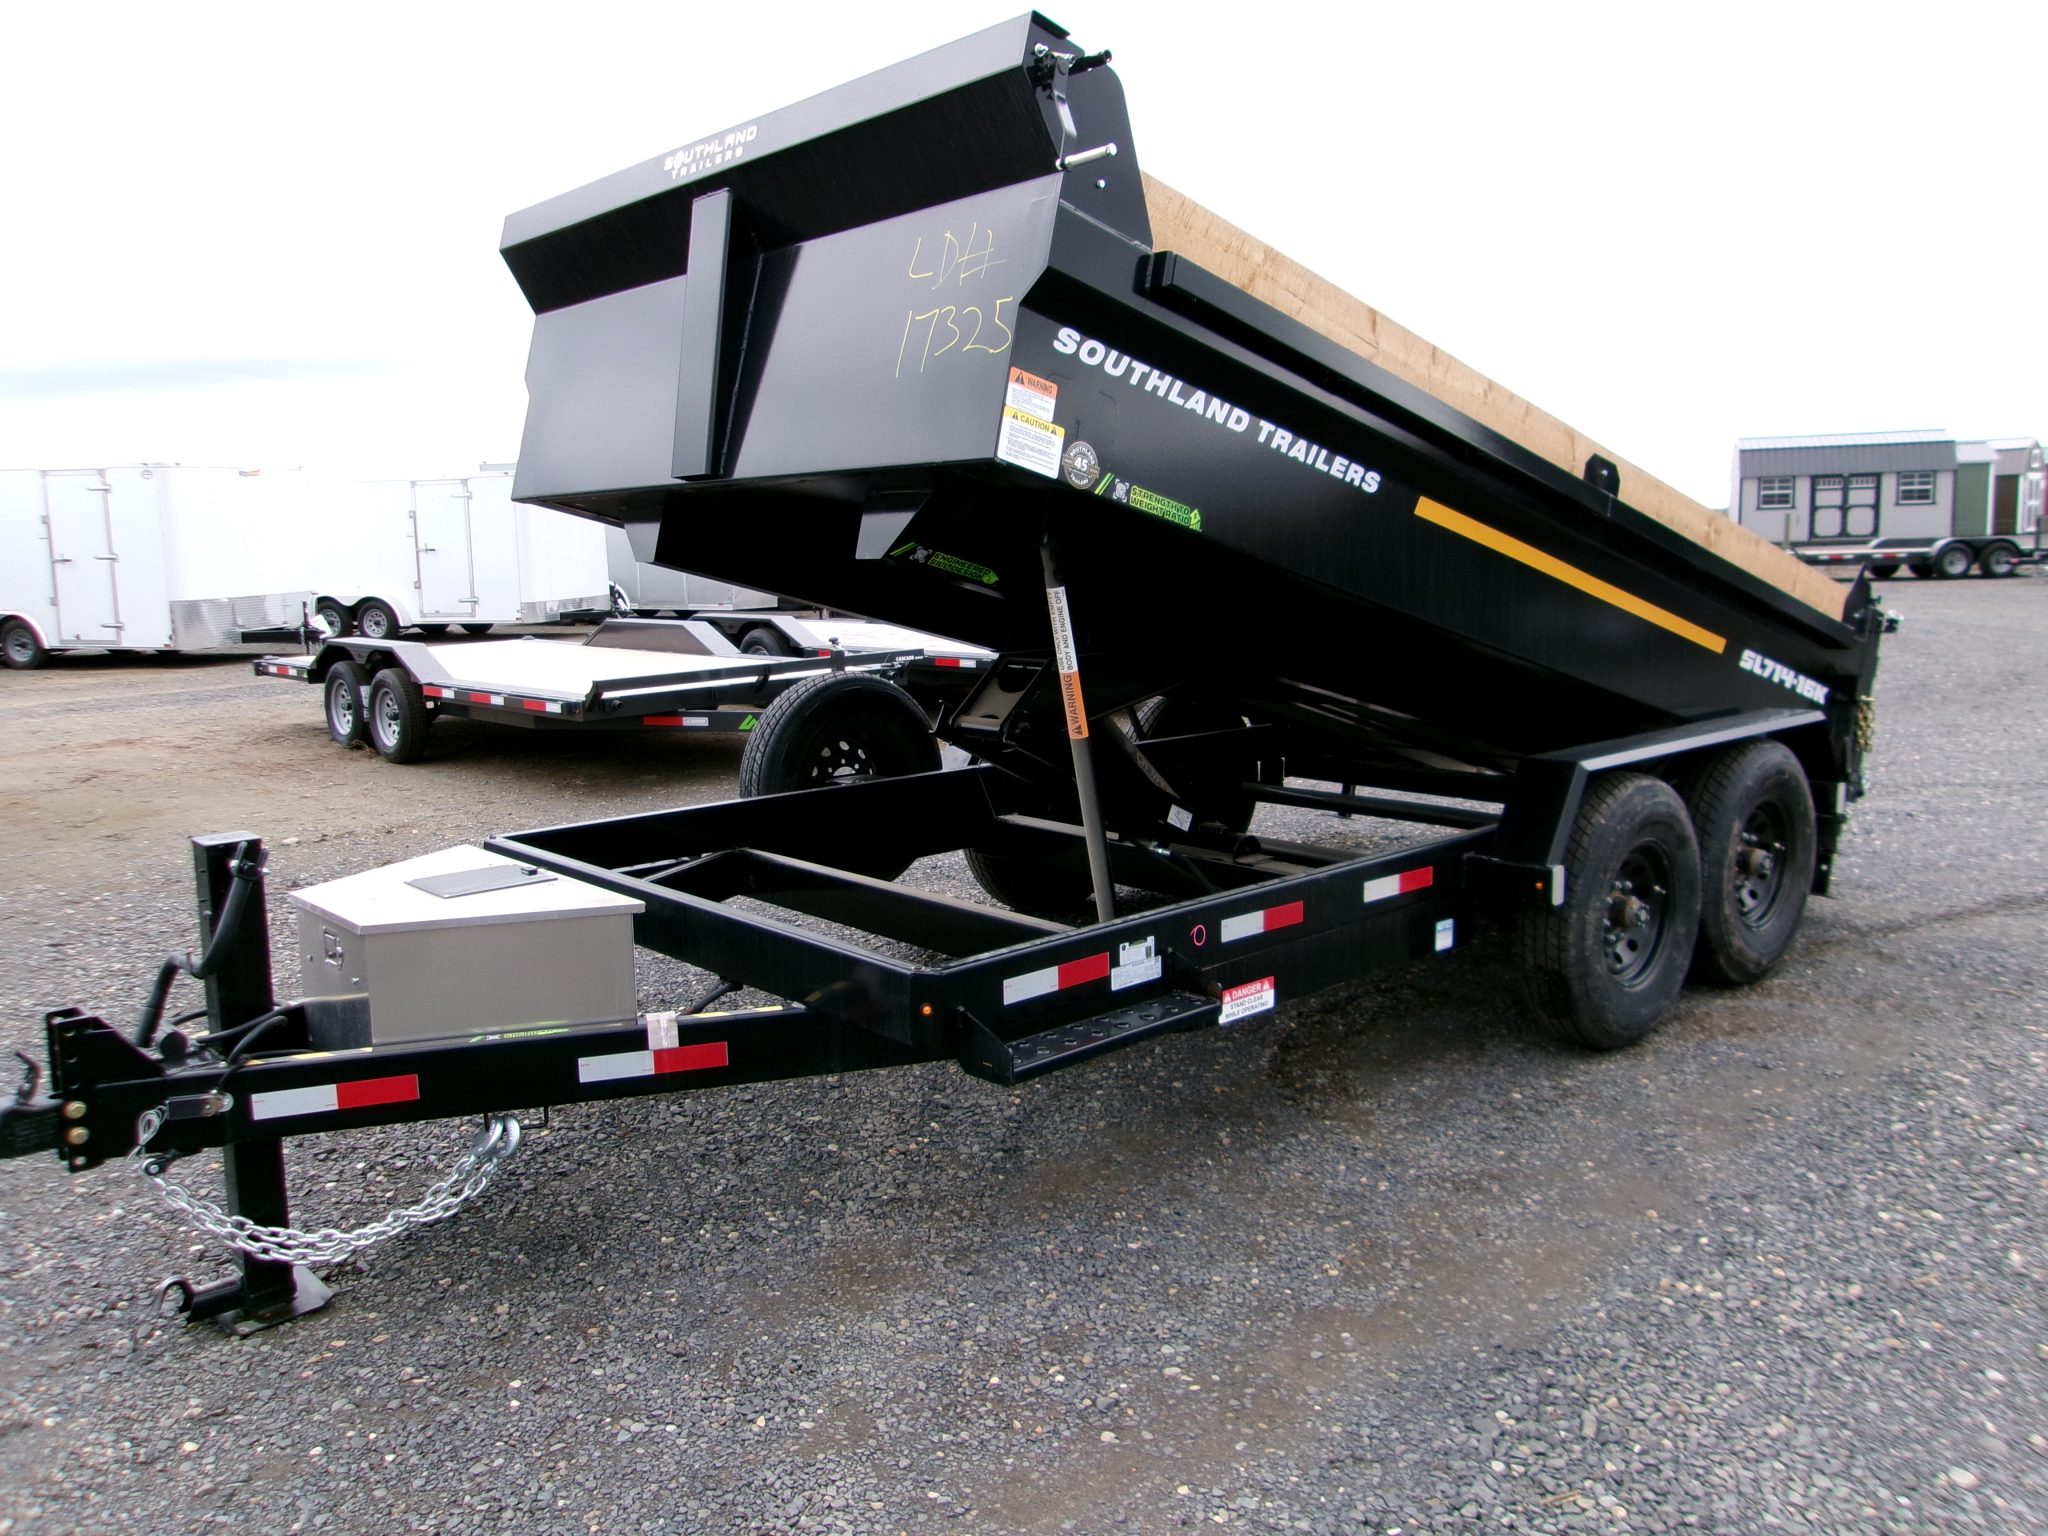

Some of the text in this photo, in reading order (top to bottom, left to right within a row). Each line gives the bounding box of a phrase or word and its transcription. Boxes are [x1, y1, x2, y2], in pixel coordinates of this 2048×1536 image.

[664, 125, 758, 171] SOUTHLAND
[672, 146, 743, 179] TRAILERS
[896, 296, 1013, 378] 17325
[1027, 377, 1053, 394] WARNING
[1053, 327, 1381, 494] SOUTHLAND TRAILERS
[1020, 414, 1050, 432] CAUTION
[1074, 456, 1088, 471] 45
[1131, 487, 1178, 511] STRENGTH
[1130, 497, 1190, 525] WEIGHT RATIO
[1054, 590, 1062, 604] OFF
[1056, 606, 1067, 633] ENGINE
[1061, 634, 1070, 649] AND
[1065, 651, 1073, 671] BODY
[1063, 674, 1078, 725] WARNING
[1232, 983, 1262, 1000] DANGER
[1225, 1000, 1269, 1019] WHILE OPERATING
[1230, 994, 1264, 1010] STAND CLEAR
